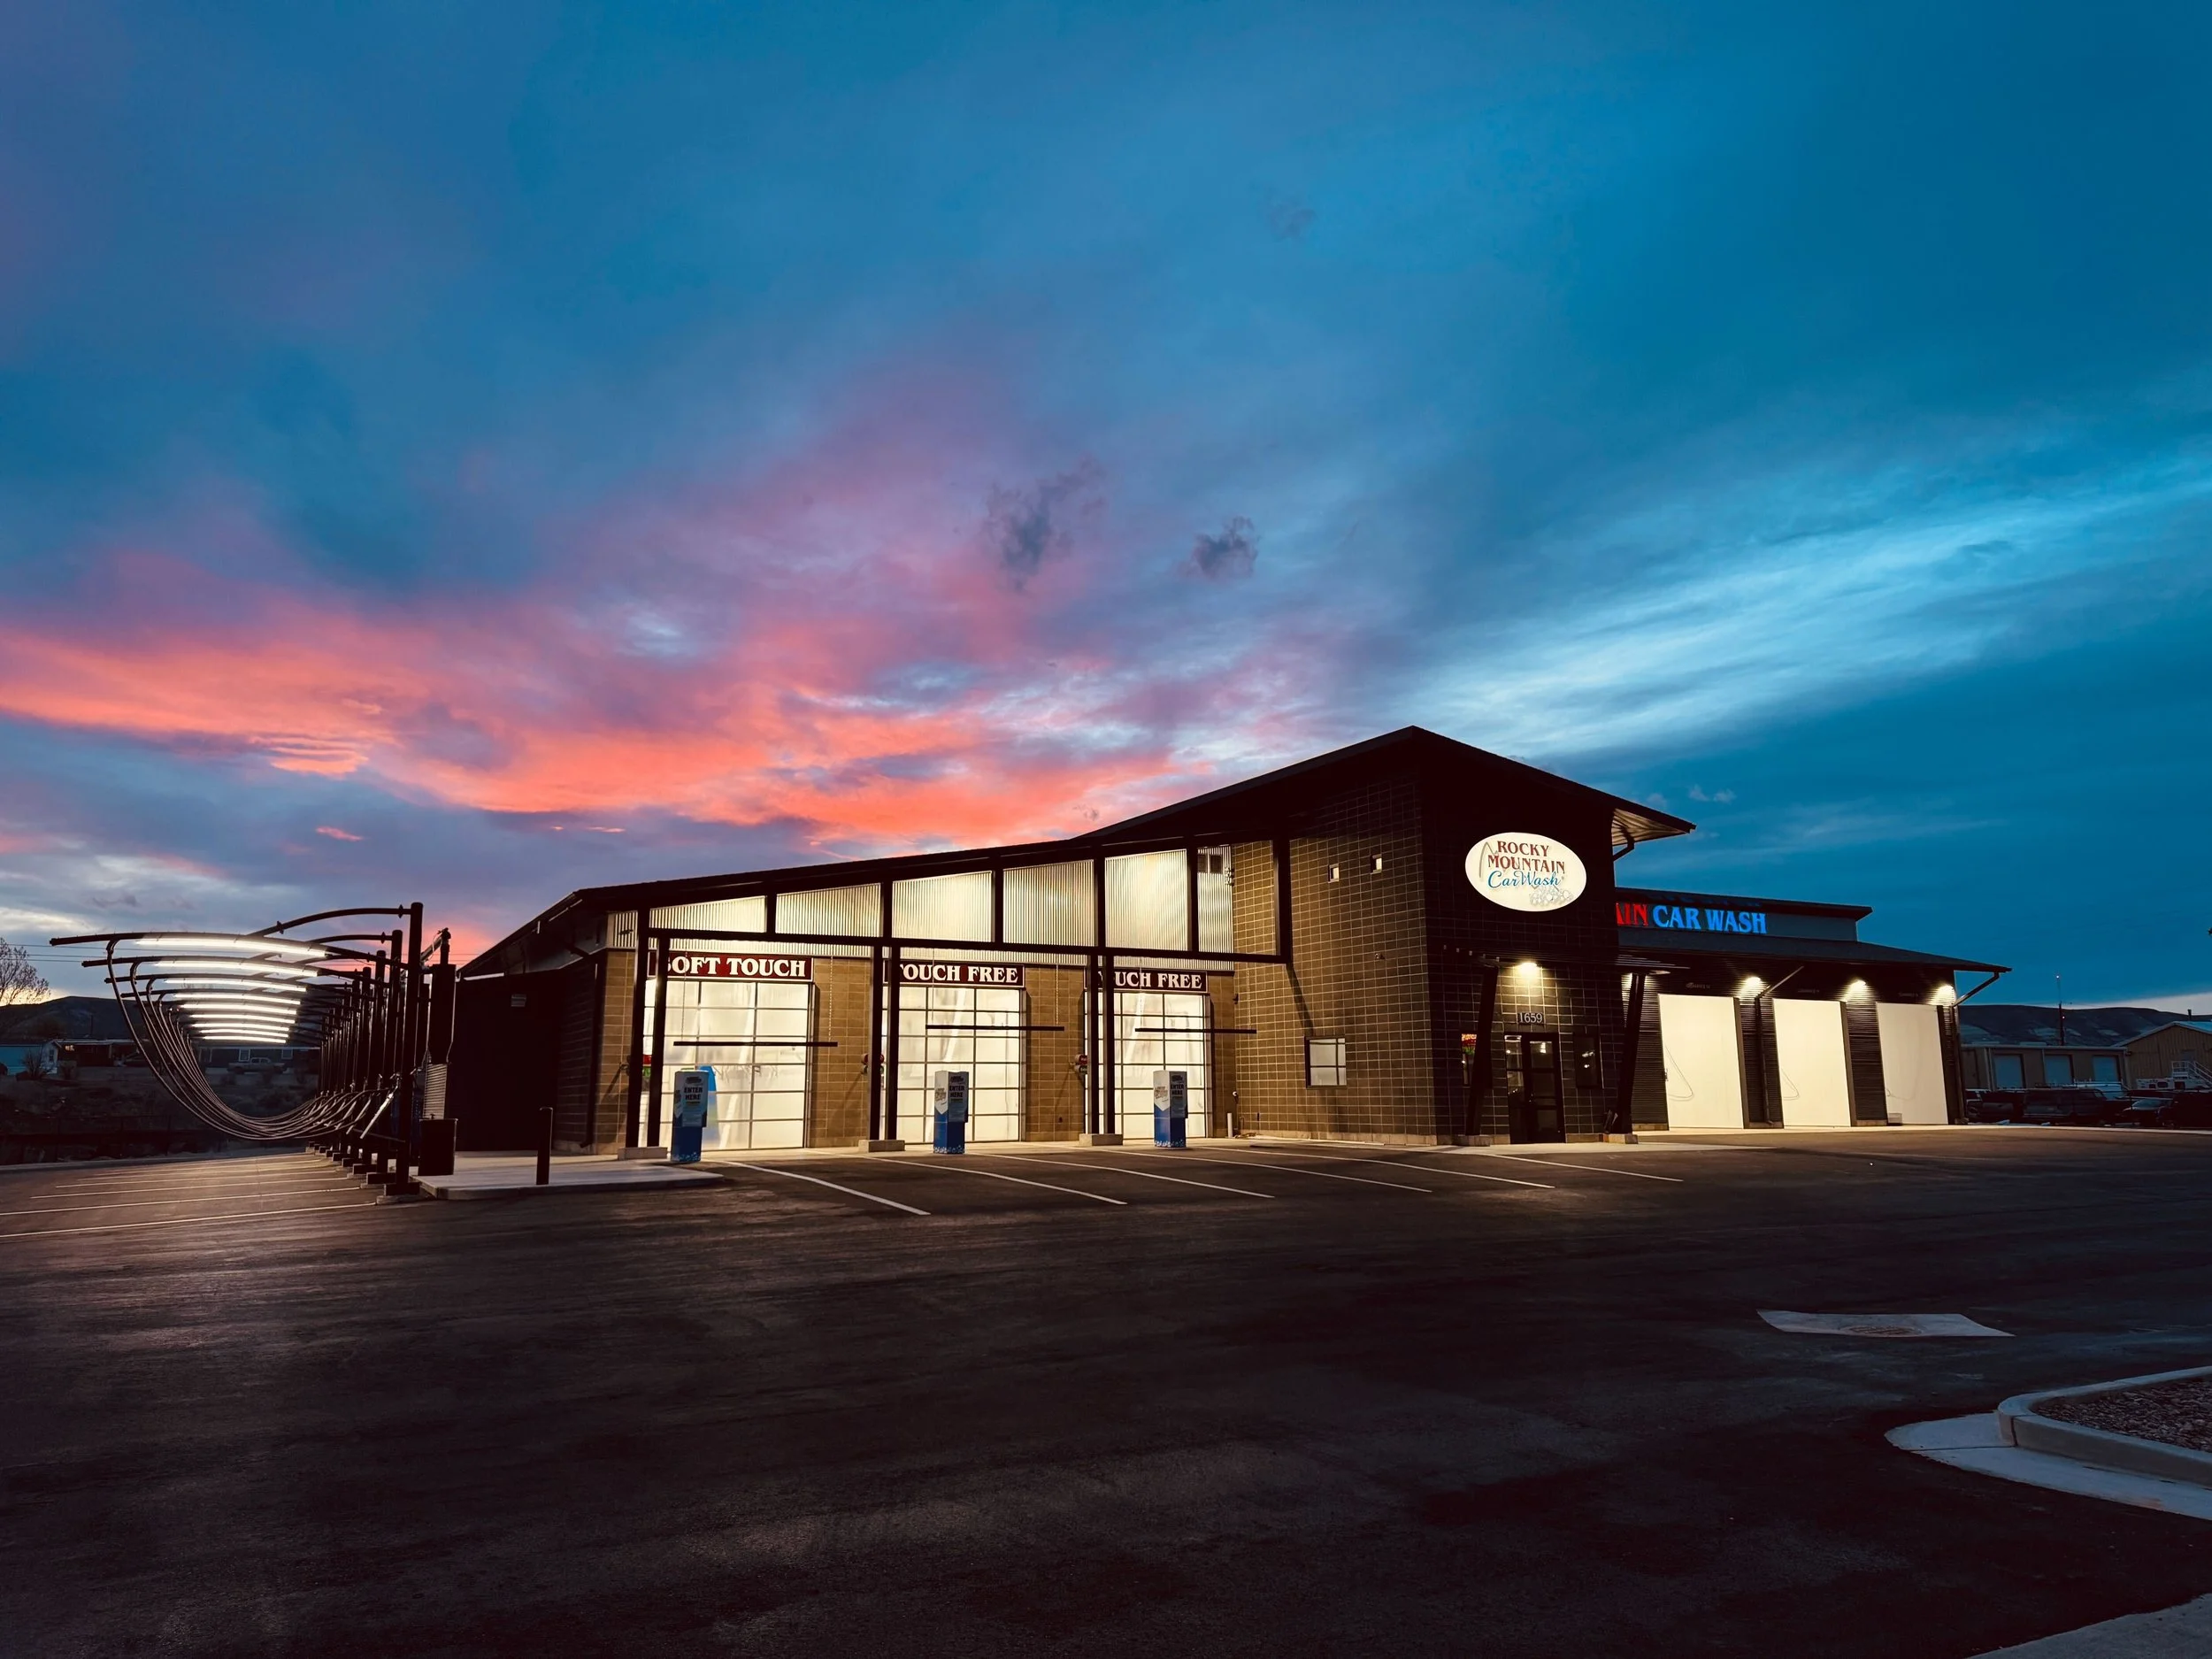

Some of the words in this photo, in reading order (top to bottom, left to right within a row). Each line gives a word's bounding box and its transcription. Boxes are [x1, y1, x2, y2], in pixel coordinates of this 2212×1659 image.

[1497, 841, 1549, 856] ROCKY
[1487, 855, 1565, 874] MOUNTAIN
[1653, 905, 1701, 929] CAR
[1705, 909, 1767, 934] WASH
[668, 956, 721, 975] OFT
[726, 957, 806, 977] TOUCH
[900, 964, 960, 981] OUCH
[968, 966, 1018, 983] FREE
[1157, 973, 1202, 988] FREE
[1518, 1012, 1543, 1024] 1659
